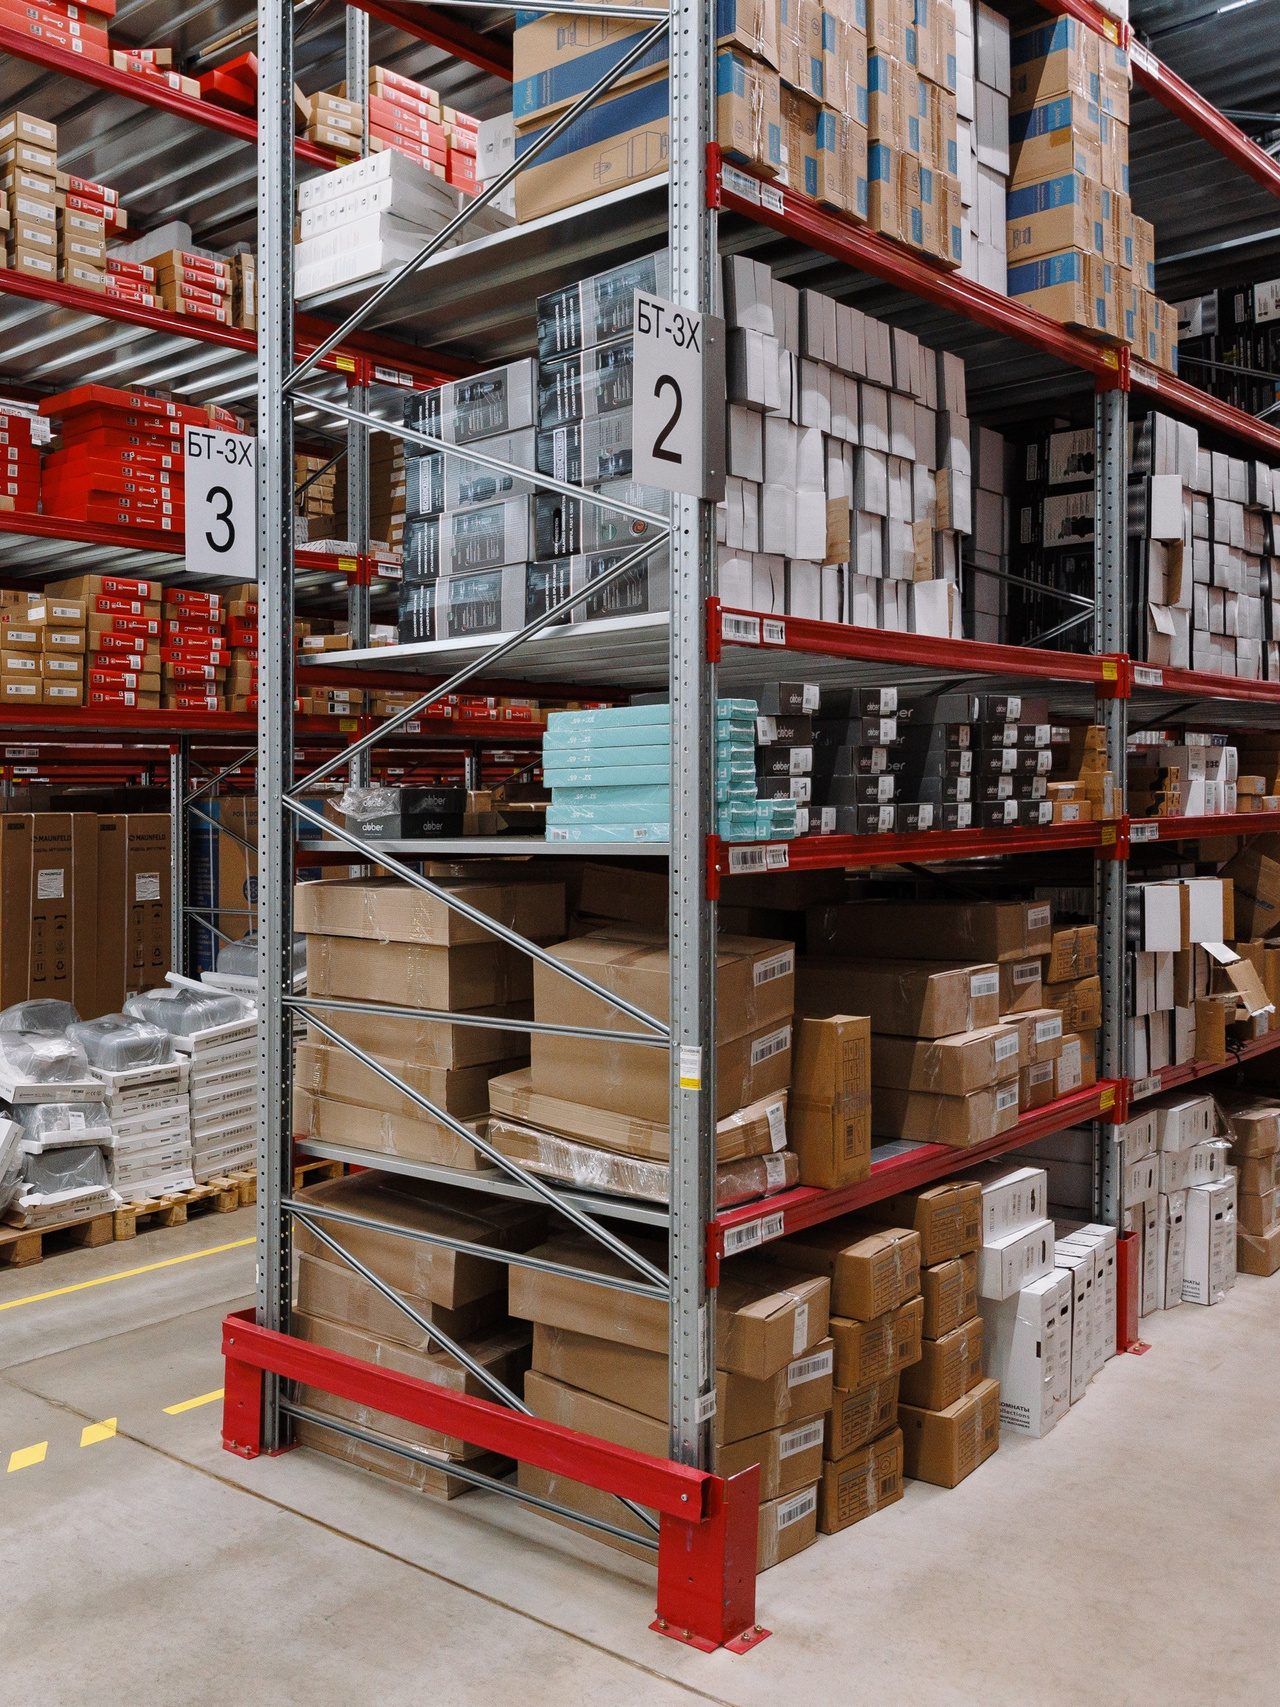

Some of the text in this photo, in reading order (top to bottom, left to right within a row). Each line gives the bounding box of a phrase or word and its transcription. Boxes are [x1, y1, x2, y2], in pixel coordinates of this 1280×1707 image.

[652, 374, 682, 464] 2
[205, 486, 235, 553] 3
[362, 822, 384, 831] abber
[423, 821, 443, 831] abber
[1000, 1402, 1030, 1412] ОМНАТЫ
